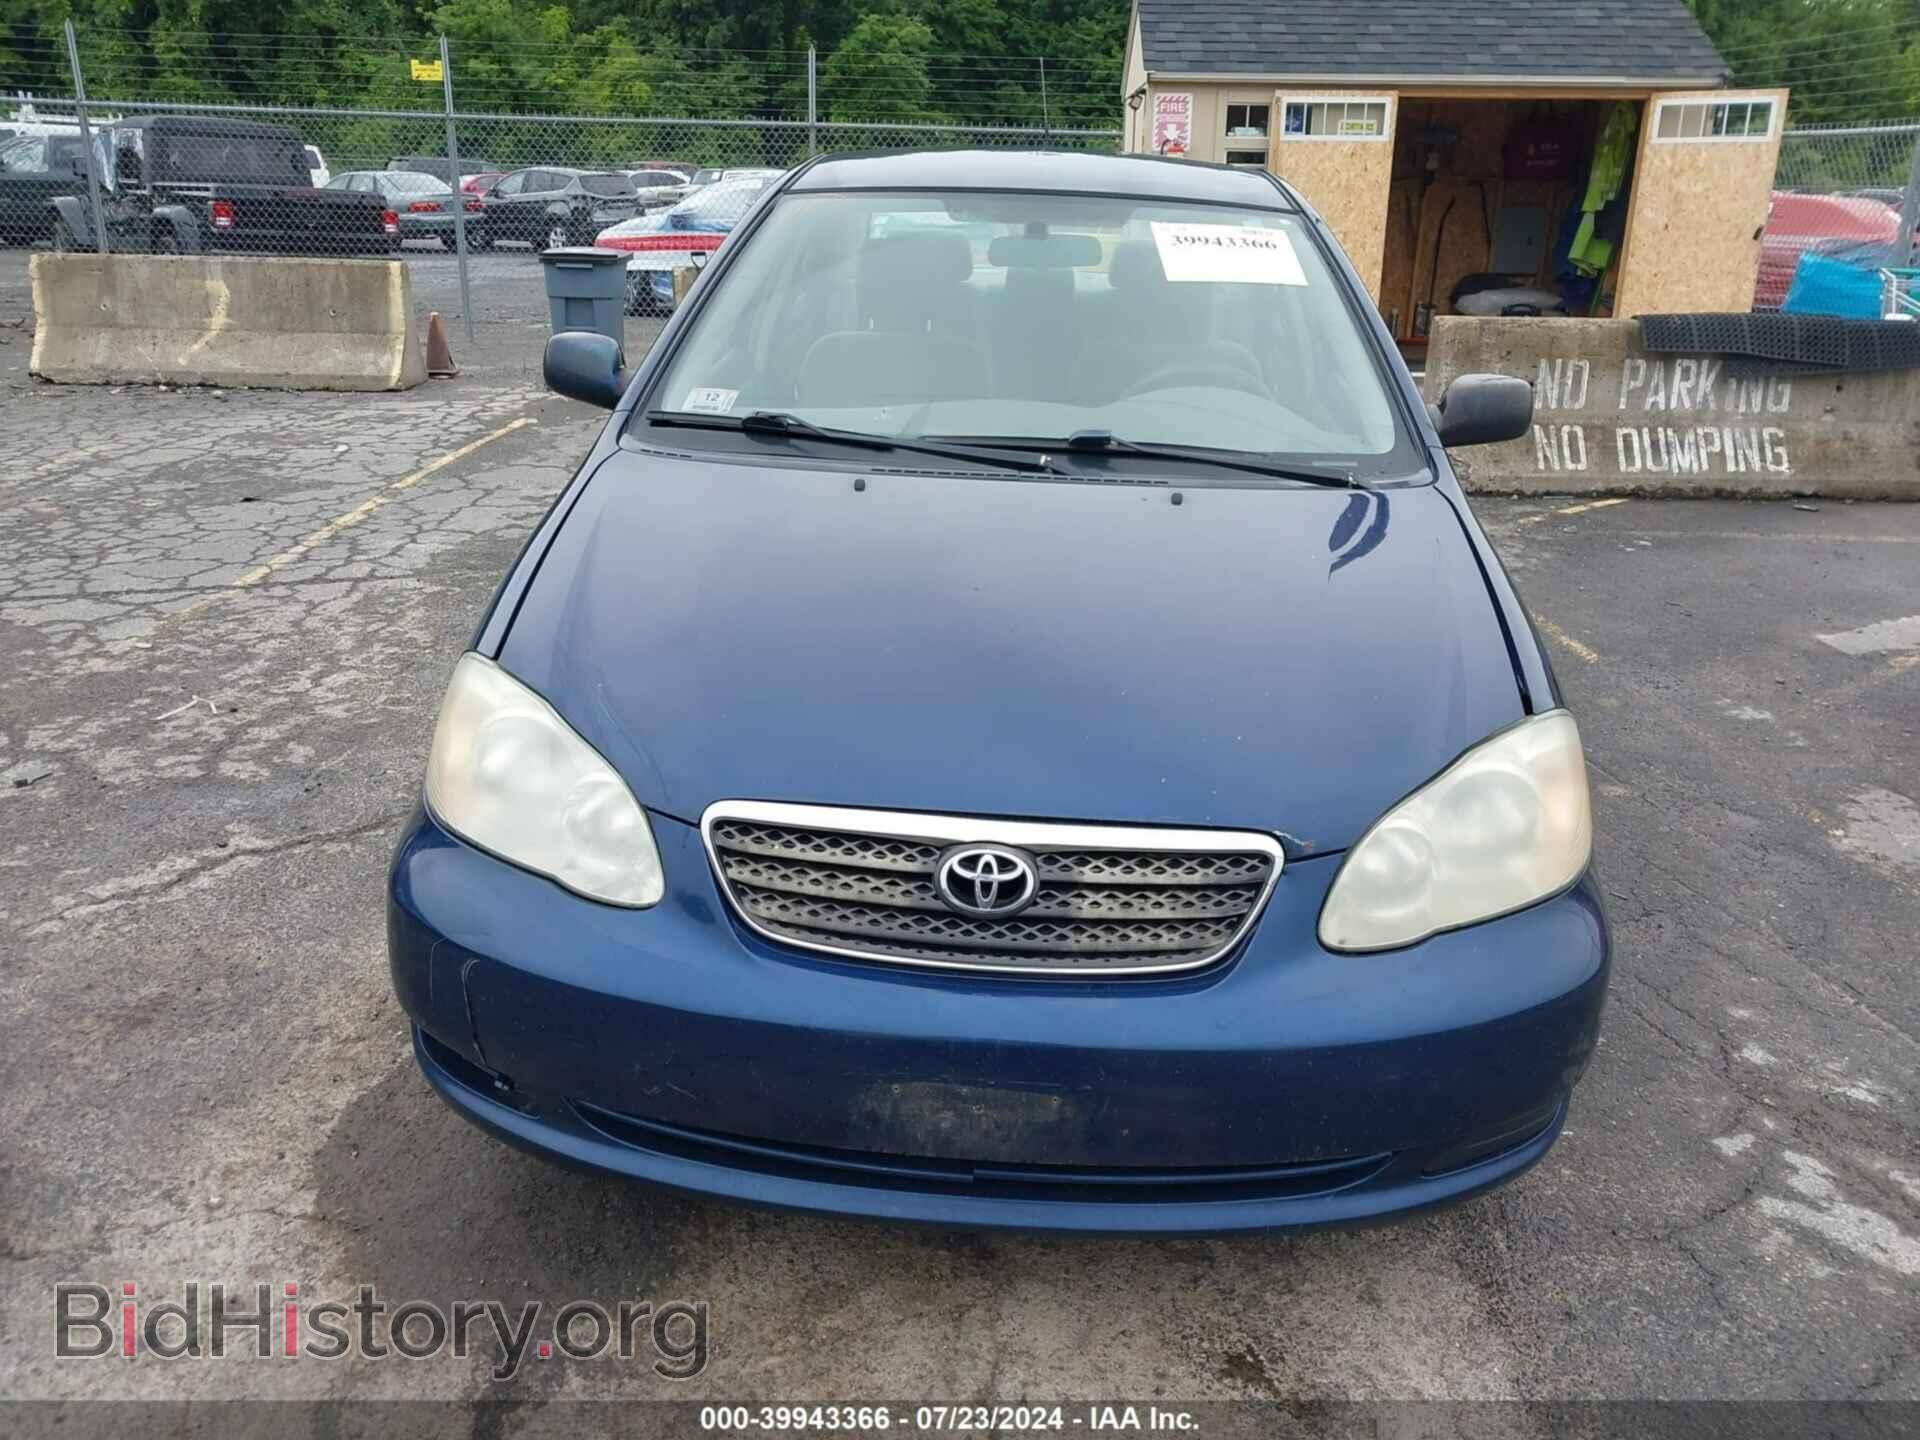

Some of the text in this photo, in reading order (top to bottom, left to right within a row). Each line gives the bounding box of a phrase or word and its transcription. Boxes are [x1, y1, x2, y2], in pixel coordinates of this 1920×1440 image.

[1160, 102, 1185, 113] FIRE
[1171, 234, 1278, 250] 39943366
[1534, 358, 1792, 414] NO PARKING
[705, 392, 721, 402] 12
[1533, 424, 1793, 475] NO DUMPING
